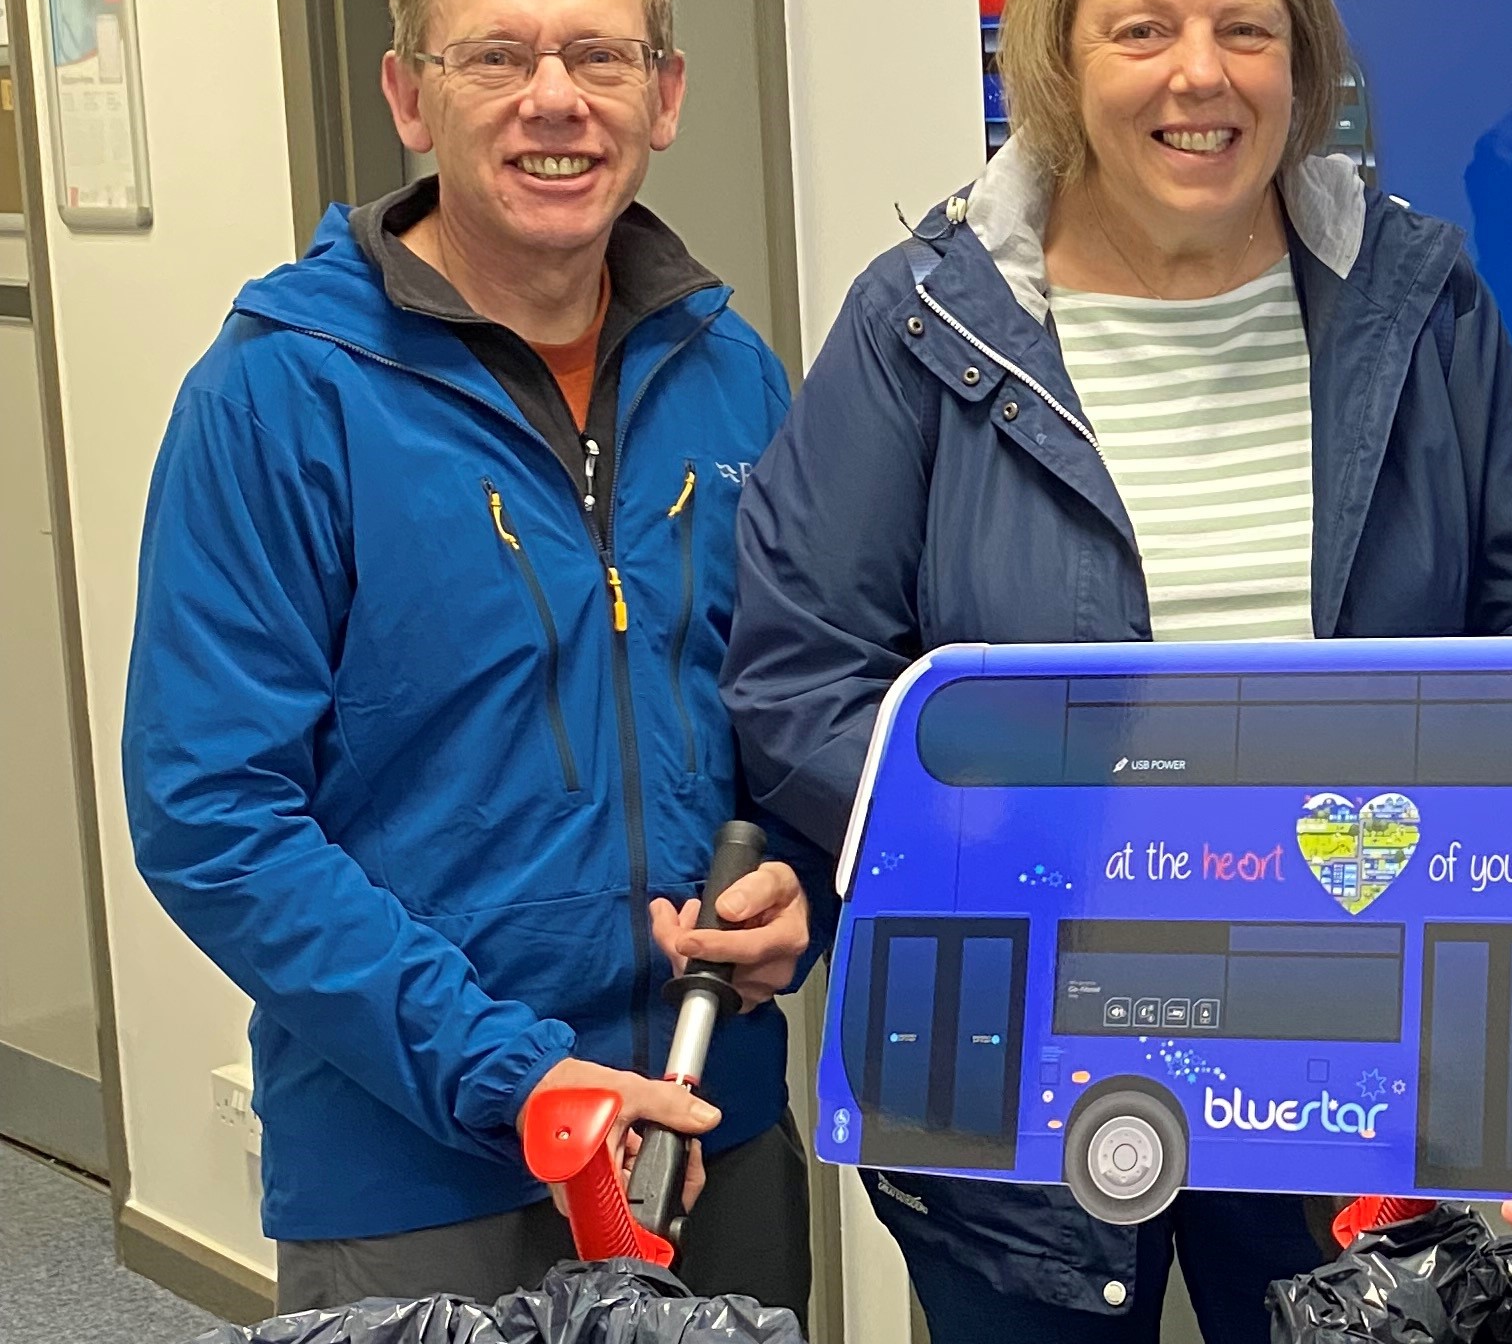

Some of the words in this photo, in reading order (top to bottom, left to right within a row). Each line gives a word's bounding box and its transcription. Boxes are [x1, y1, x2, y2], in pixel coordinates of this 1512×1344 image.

[1131, 760, 1150, 770] USB
[1150, 760, 1186, 770] POWER
[1105, 842, 1135, 881] at
[1146, 841, 1192, 881] the
[1202, 843, 1286, 882] heart
[1429, 842, 1462, 883] of
[1204, 1088, 1389, 1132] bluestar
